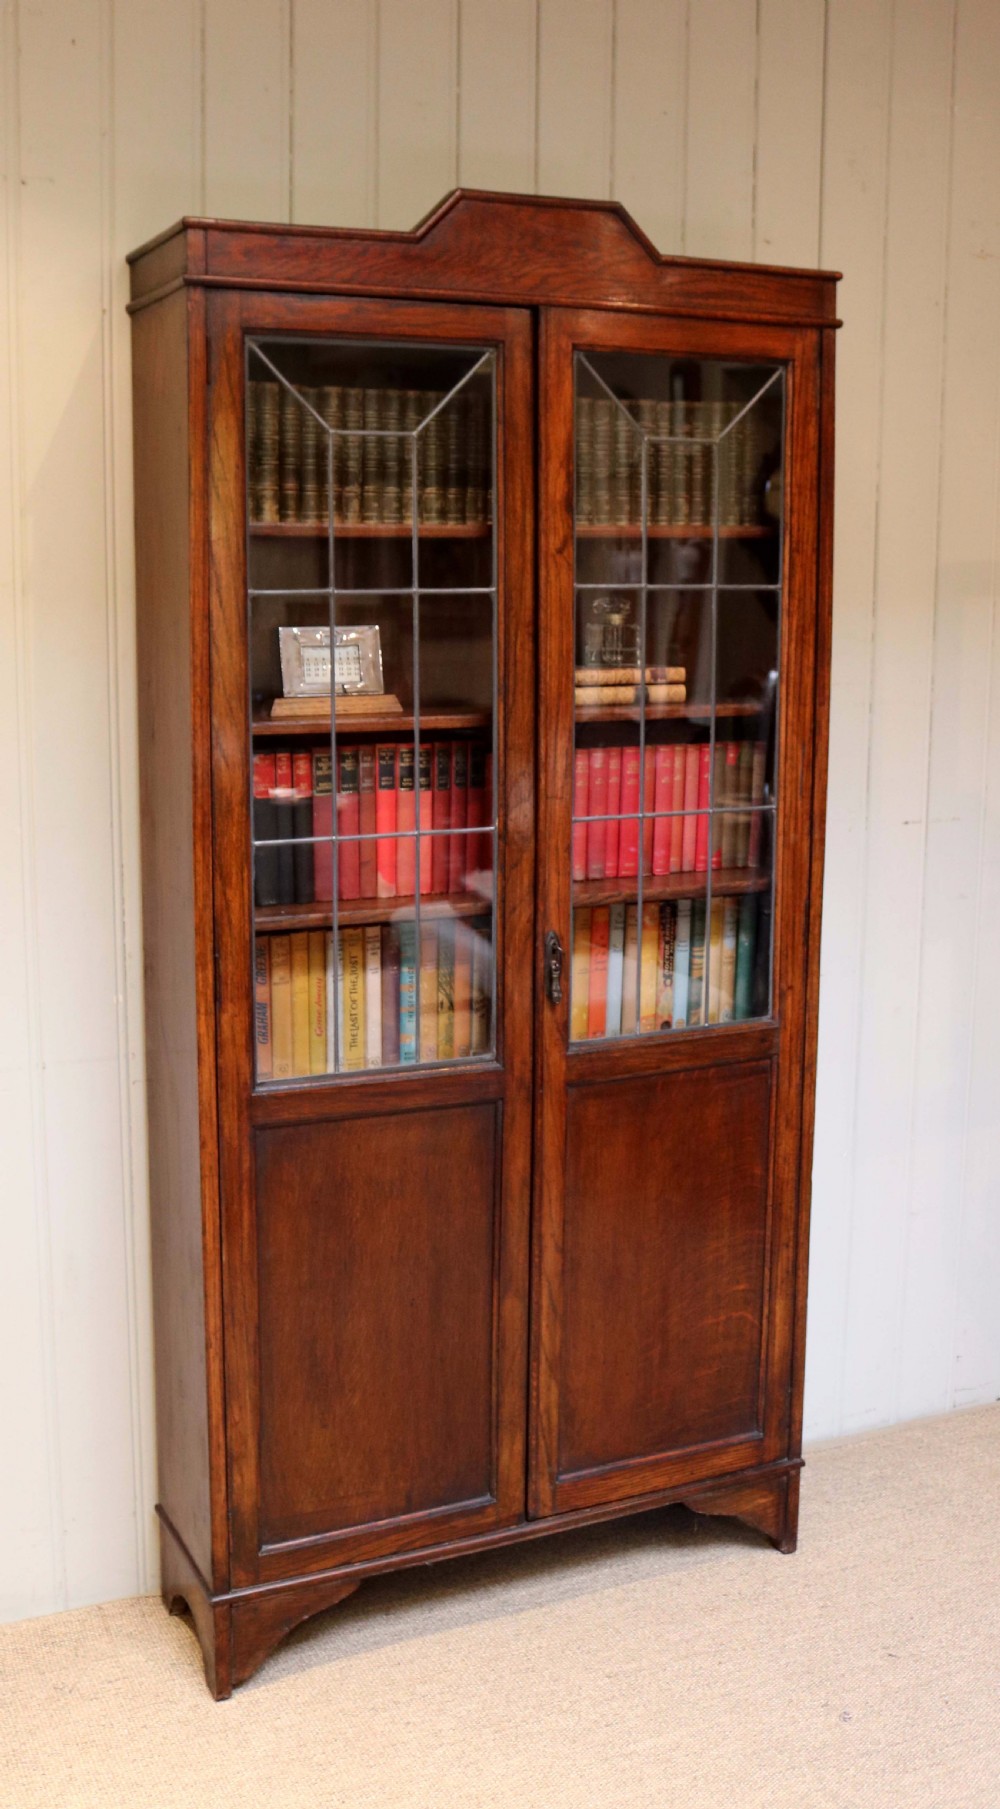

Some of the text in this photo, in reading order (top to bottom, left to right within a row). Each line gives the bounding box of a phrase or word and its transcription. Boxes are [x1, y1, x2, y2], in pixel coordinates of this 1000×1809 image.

[350, 954, 358, 979] JUST
[256, 946, 269, 1045] GRAHAM GREENE
[350, 1013, 359, 1030] LAST
[350, 1030, 358, 1050] THE
